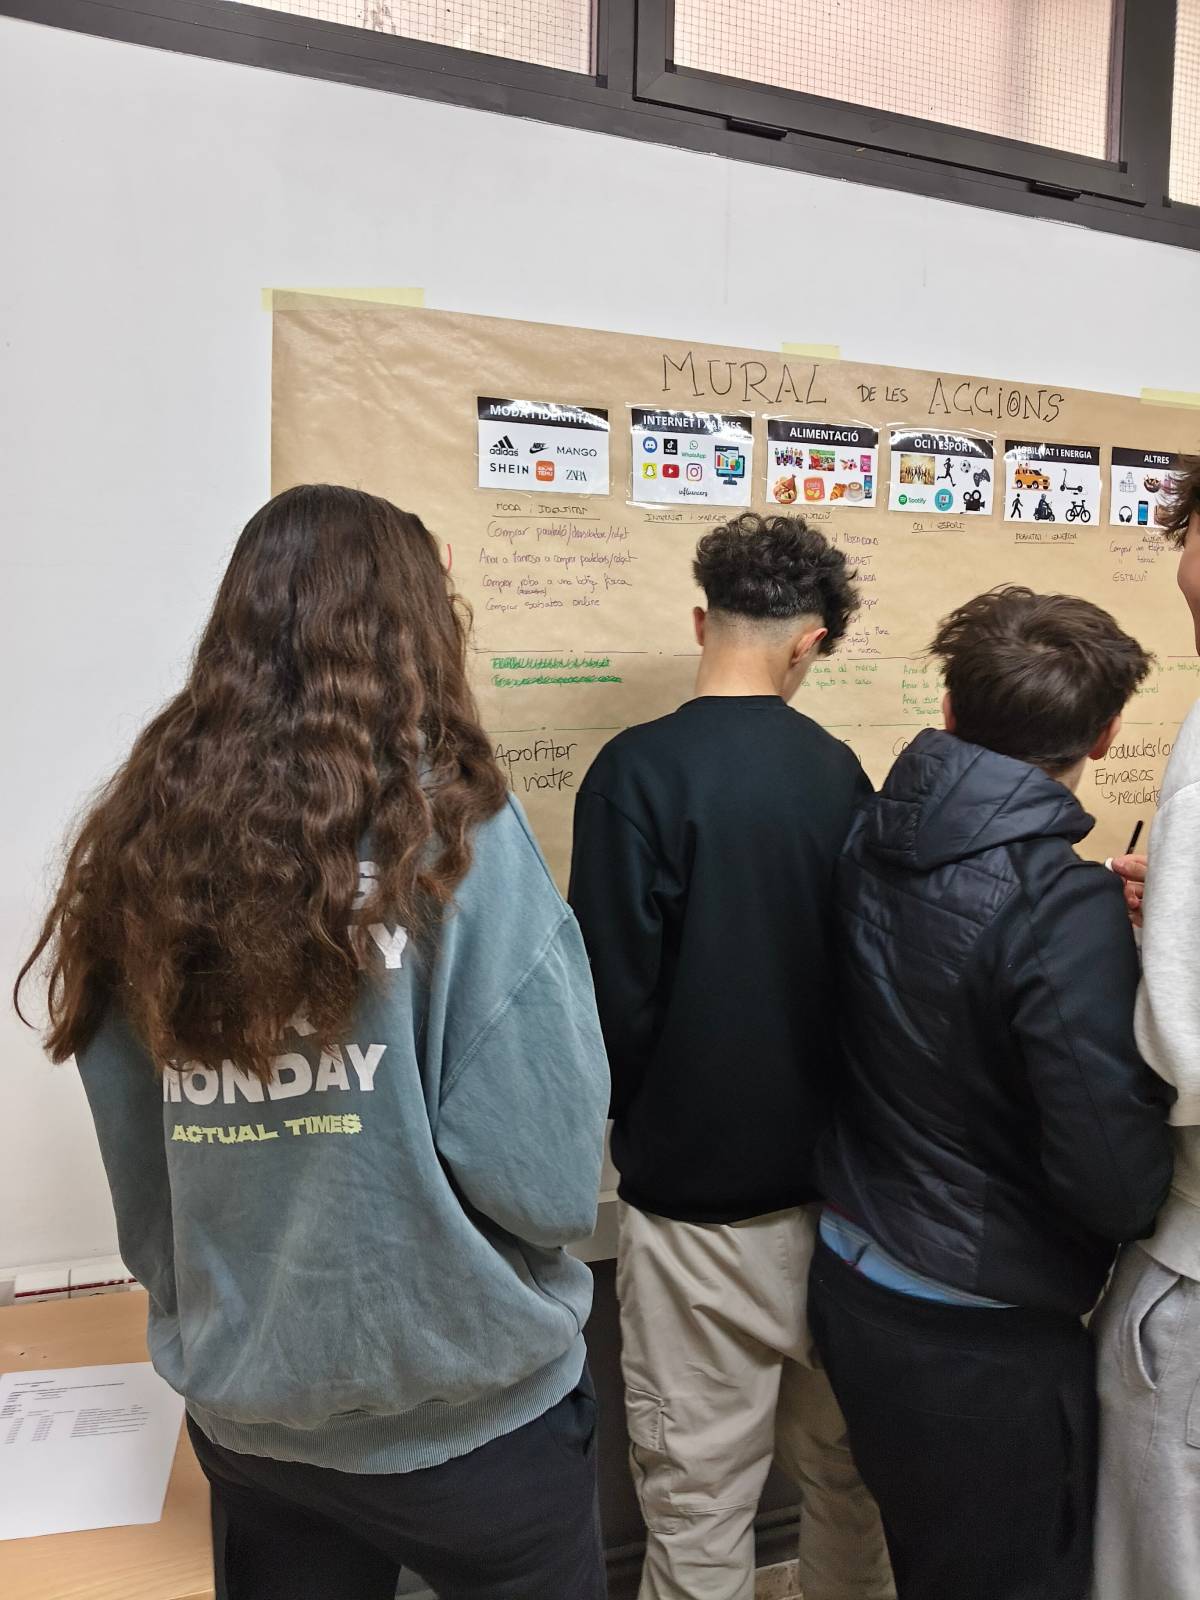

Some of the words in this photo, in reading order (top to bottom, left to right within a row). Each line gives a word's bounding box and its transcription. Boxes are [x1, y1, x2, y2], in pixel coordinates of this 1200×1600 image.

[662, 351, 828, 404] MURAL
[857, 383, 877, 404] DE
[884, 385, 909, 404] LES
[643, 414, 695, 428] INTERNET
[789, 427, 859, 442] ALIMENTACIÓ
[489, 448, 519, 457] adidas
[556, 446, 598, 457] MANGO
[914, 439, 931, 449] OCI
[939, 441, 973, 453] ESPORT
[1061, 449, 1092, 460] ENERGIA
[1143, 454, 1170, 464] ALTRES
[490, 462, 529, 475] SHEIN
[565, 469, 588, 482] ZARA
[1094, 767, 1155, 786] Envasos
[162, 1043, 388, 1105] MONDAY
[170, 1123, 280, 1145] ACTUAL
[283, 1112, 364, 1137] TIMES
